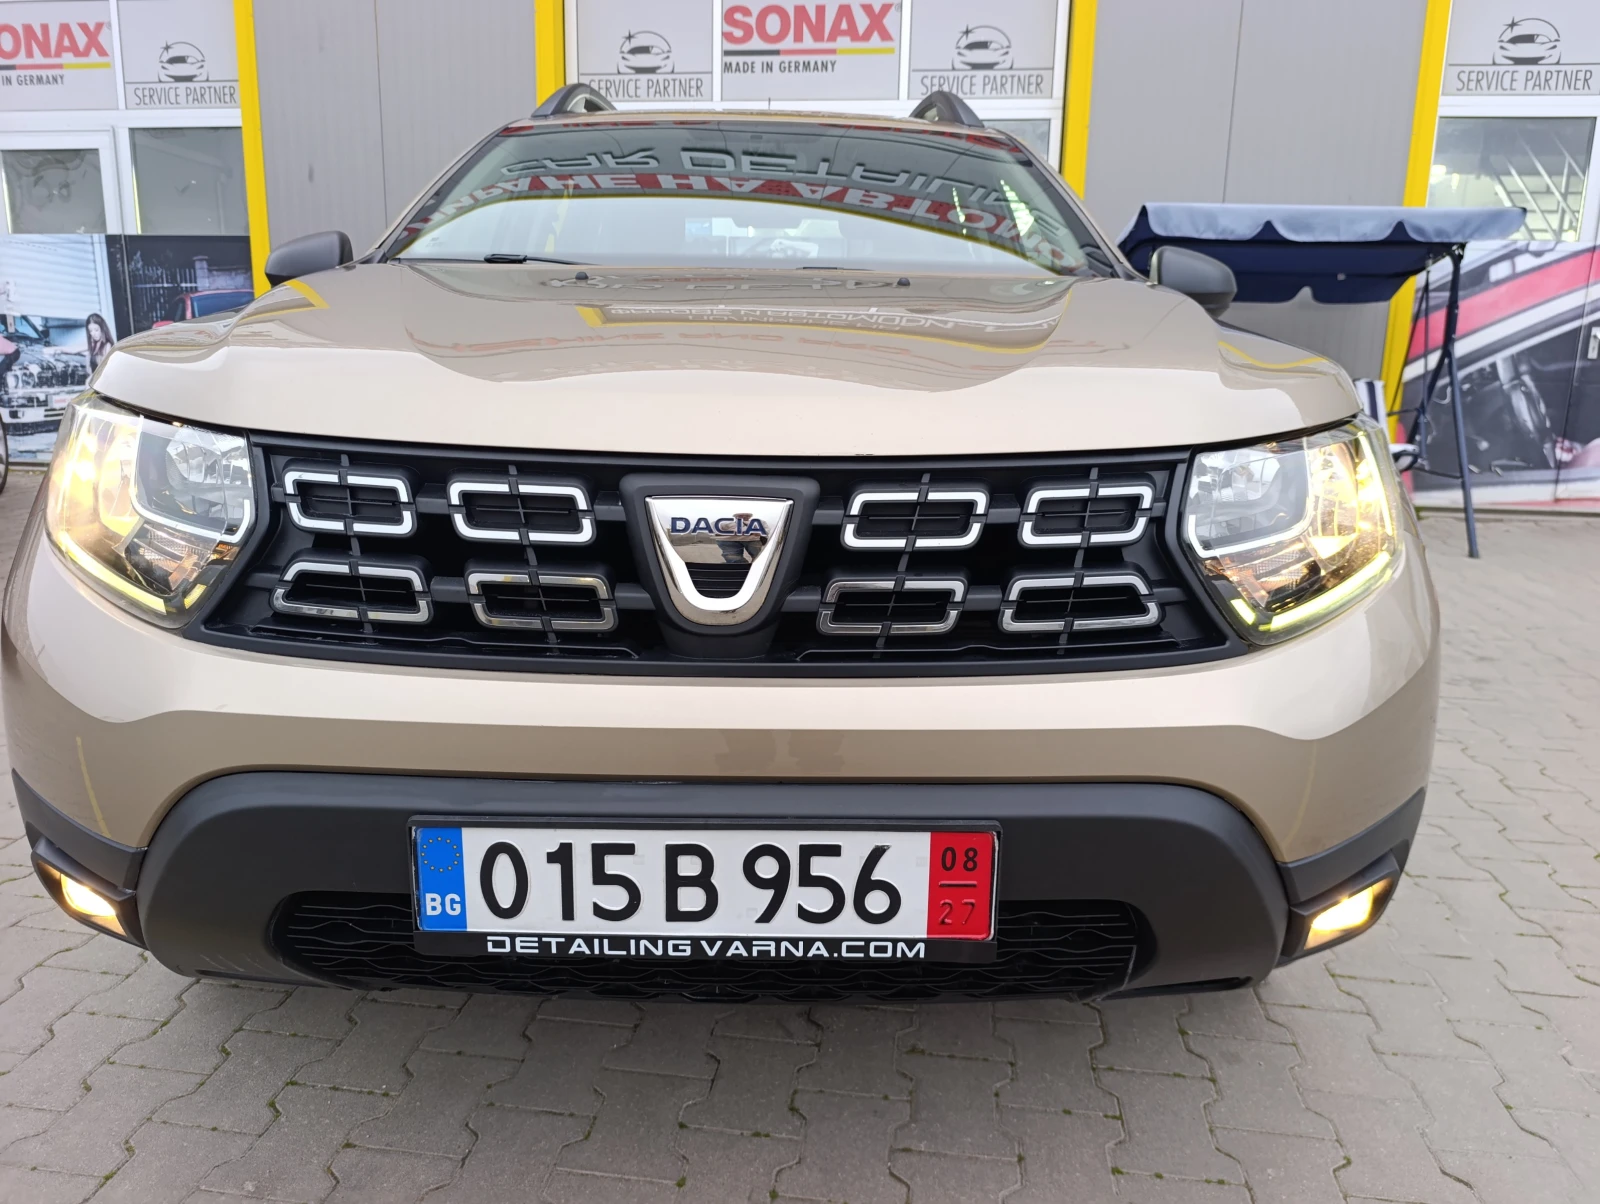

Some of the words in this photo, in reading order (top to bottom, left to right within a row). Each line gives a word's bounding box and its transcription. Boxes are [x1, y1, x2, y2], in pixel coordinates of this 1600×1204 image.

[722, 3, 894, 45] SONAX
[723, 61, 756, 74] MADE
[761, 61, 774, 73] IN
[779, 60, 837, 73] GERMANY
[1, 75, 12, 86] IN
[16, 74, 65, 86] GERMANY
[646, 77, 704, 98] PARTNER
[920, 75, 977, 95] SERVICE
[982, 74, 1044, 95] PARTNER
[1456, 70, 1518, 92] SERVICE
[1524, 69, 1593, 91] PARTNER
[134, 87, 181, 106] SERVICE
[186, 86, 237, 105] PARTNER
[670, 517, 767, 536] DACIA
[940, 846, 979, 873] 08
[479, 841, 642, 922] 015
[664, 843, 719, 923] B
[742, 843, 903, 926] 956
[425, 893, 462, 916] BG
[938, 900, 976, 926] 27
